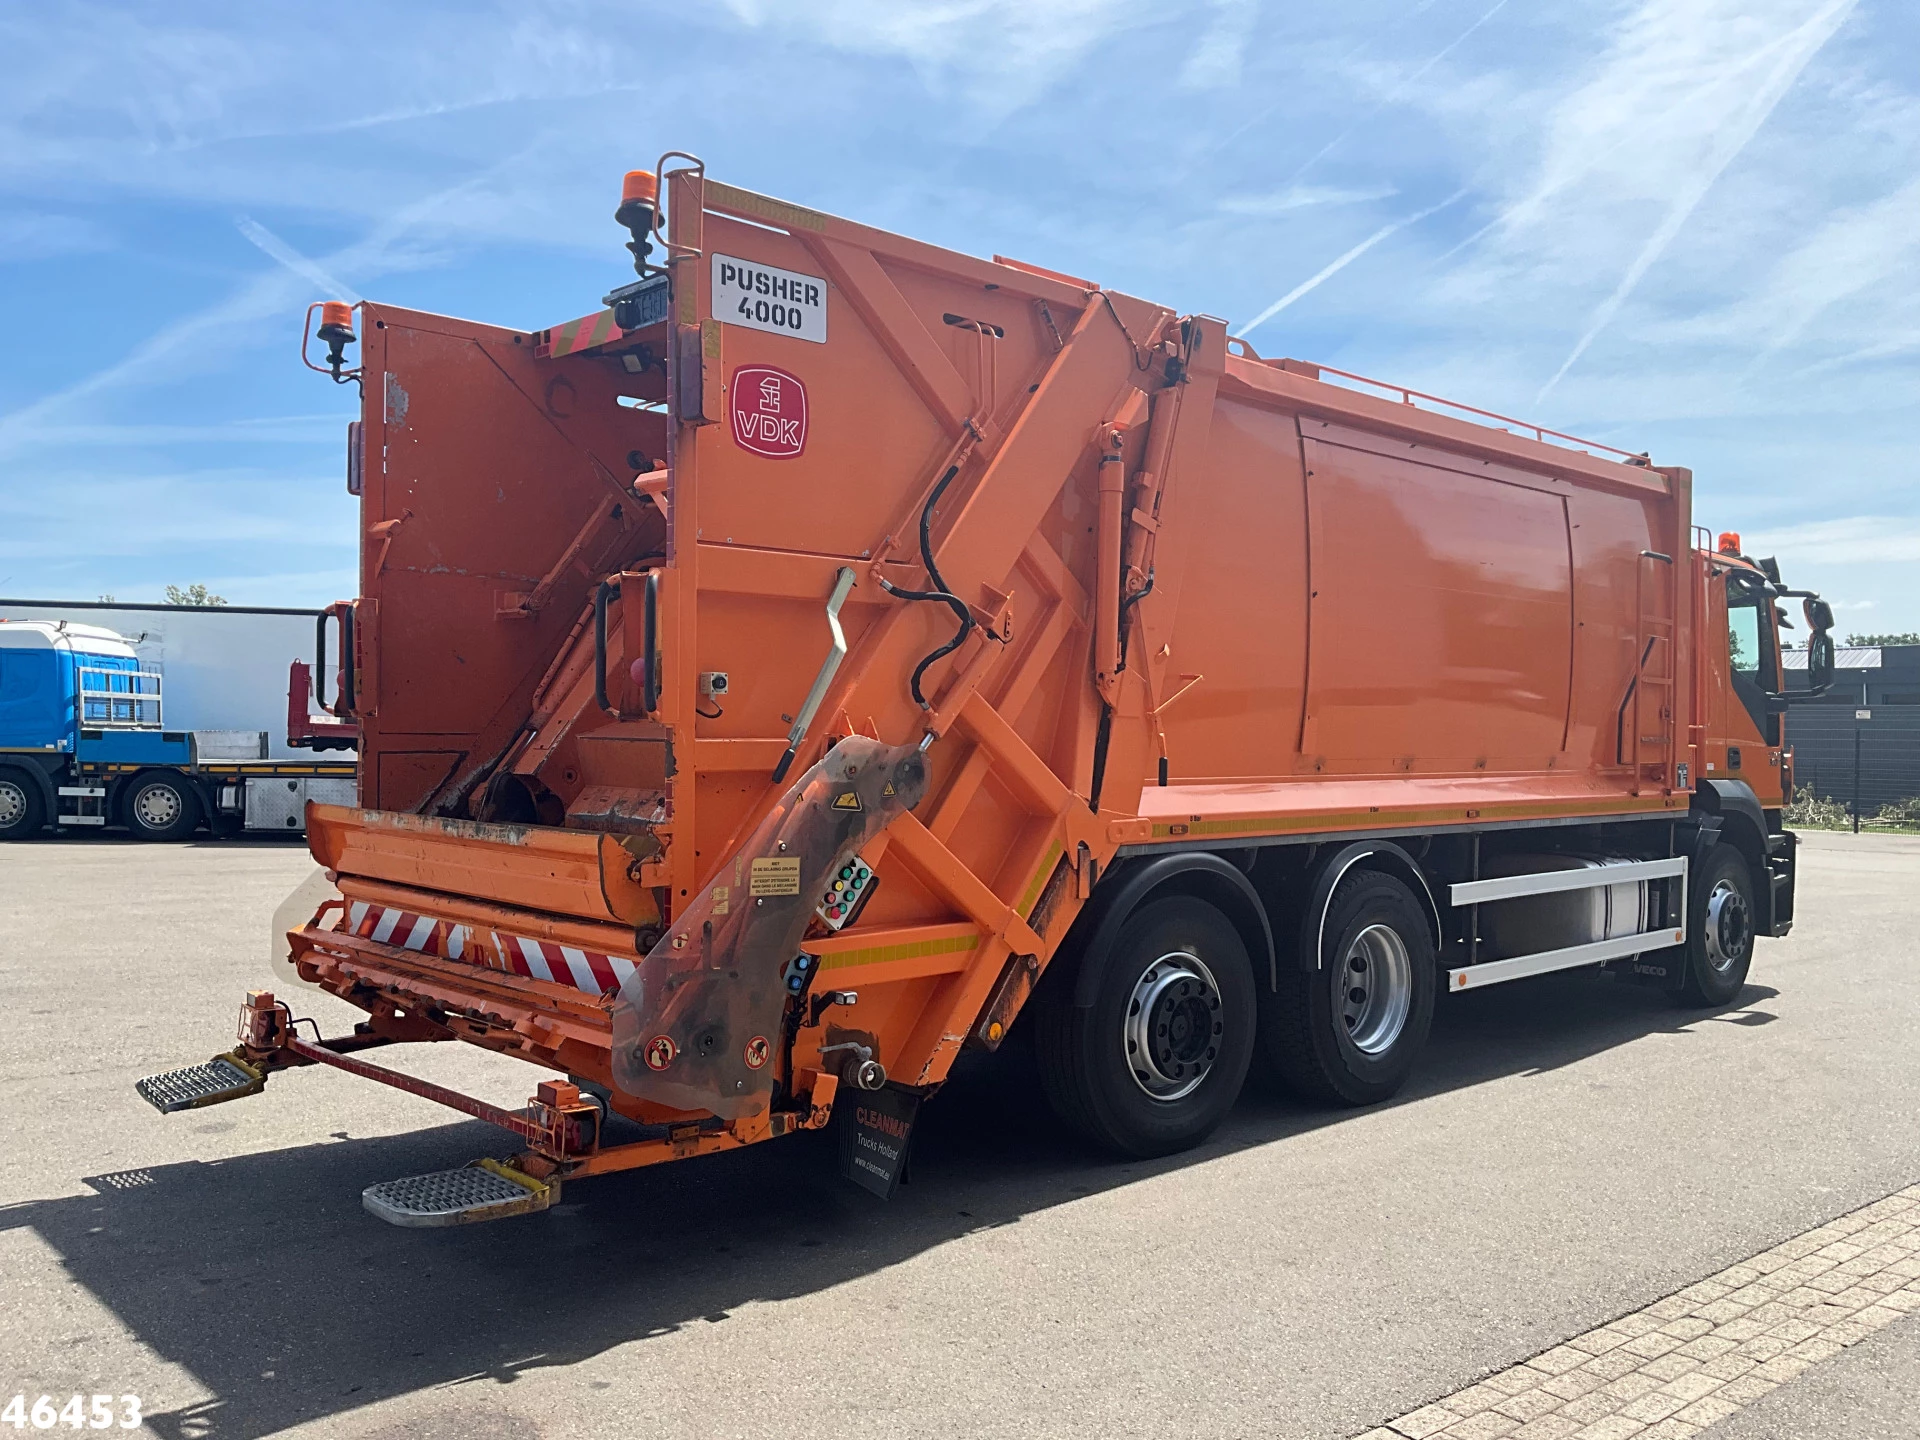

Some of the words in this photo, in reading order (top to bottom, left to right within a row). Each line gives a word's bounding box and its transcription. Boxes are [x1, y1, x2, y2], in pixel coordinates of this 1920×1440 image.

[720, 262, 819, 307] PUSHER
[738, 296, 802, 330] 4000
[737, 410, 800, 446] VDK
[1632, 964, 1667, 976] VECO
[856, 1107, 910, 1139] CLEANMAT
[857, 1132, 878, 1151] Trucks
[878, 1141, 899, 1161] Holland
